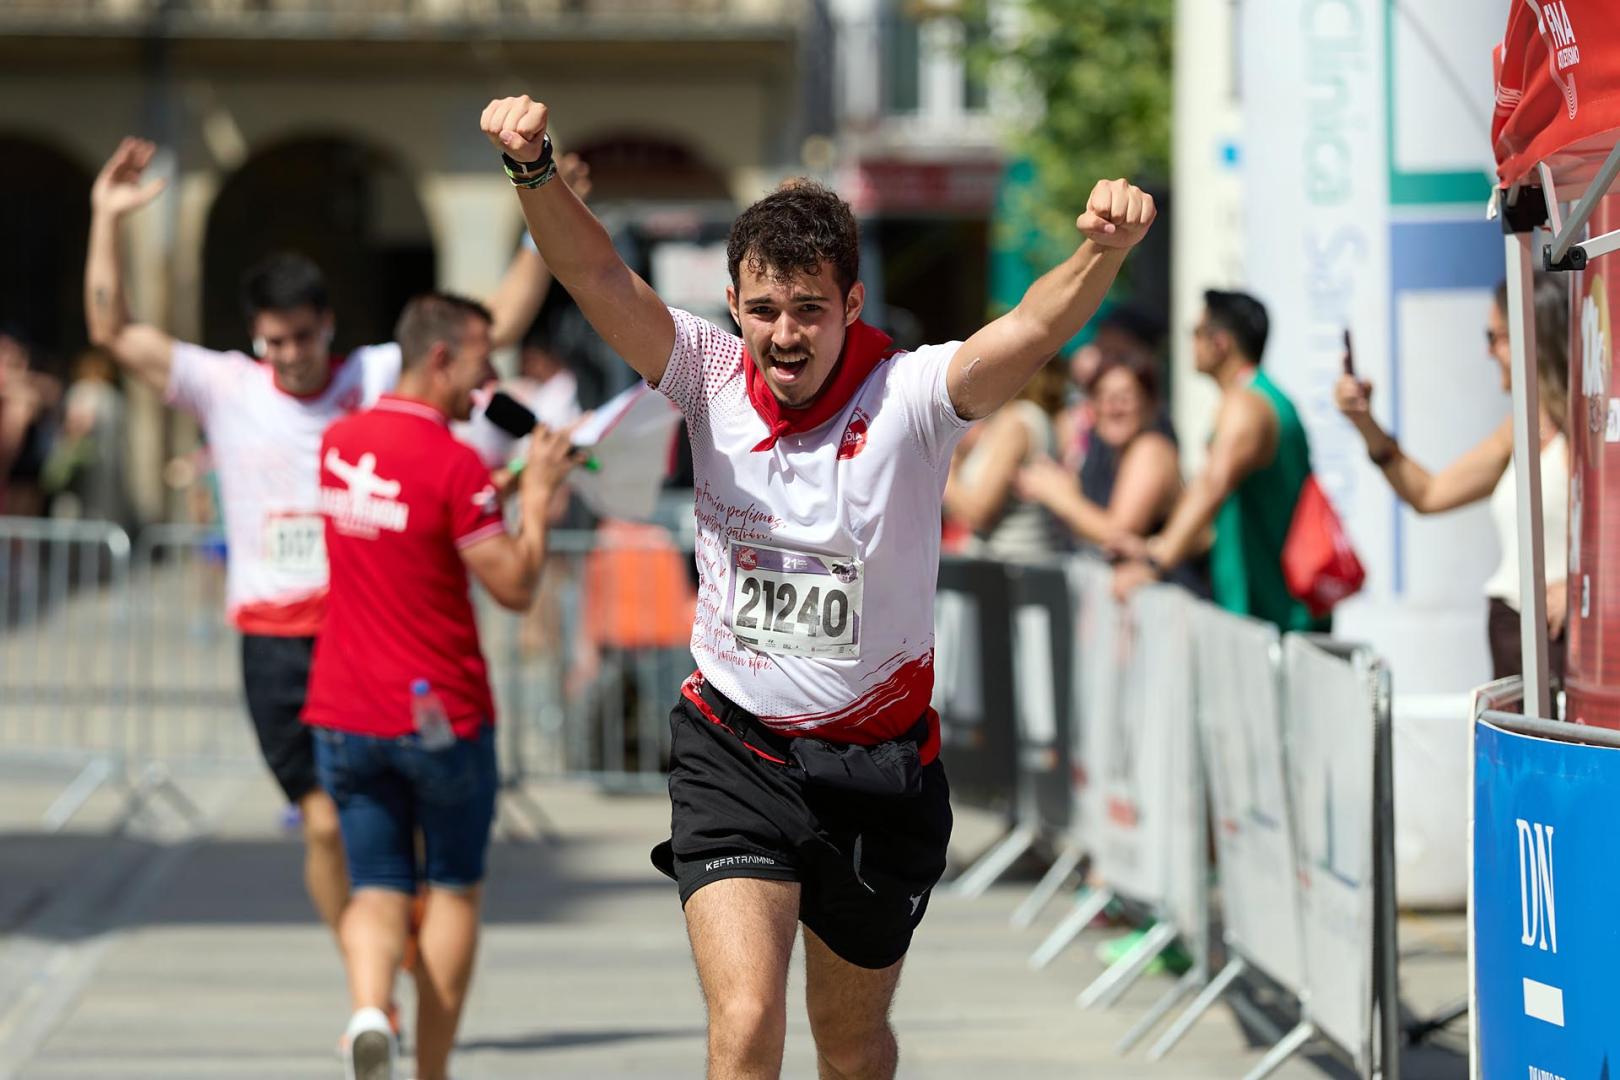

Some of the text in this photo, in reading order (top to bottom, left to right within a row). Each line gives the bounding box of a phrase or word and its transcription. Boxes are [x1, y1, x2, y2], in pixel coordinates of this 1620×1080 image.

[1543, 0, 1576, 49] FNA
[783, 557, 797, 570] 21
[736, 576, 848, 638] 21240
[1516, 818, 1557, 954] DN
